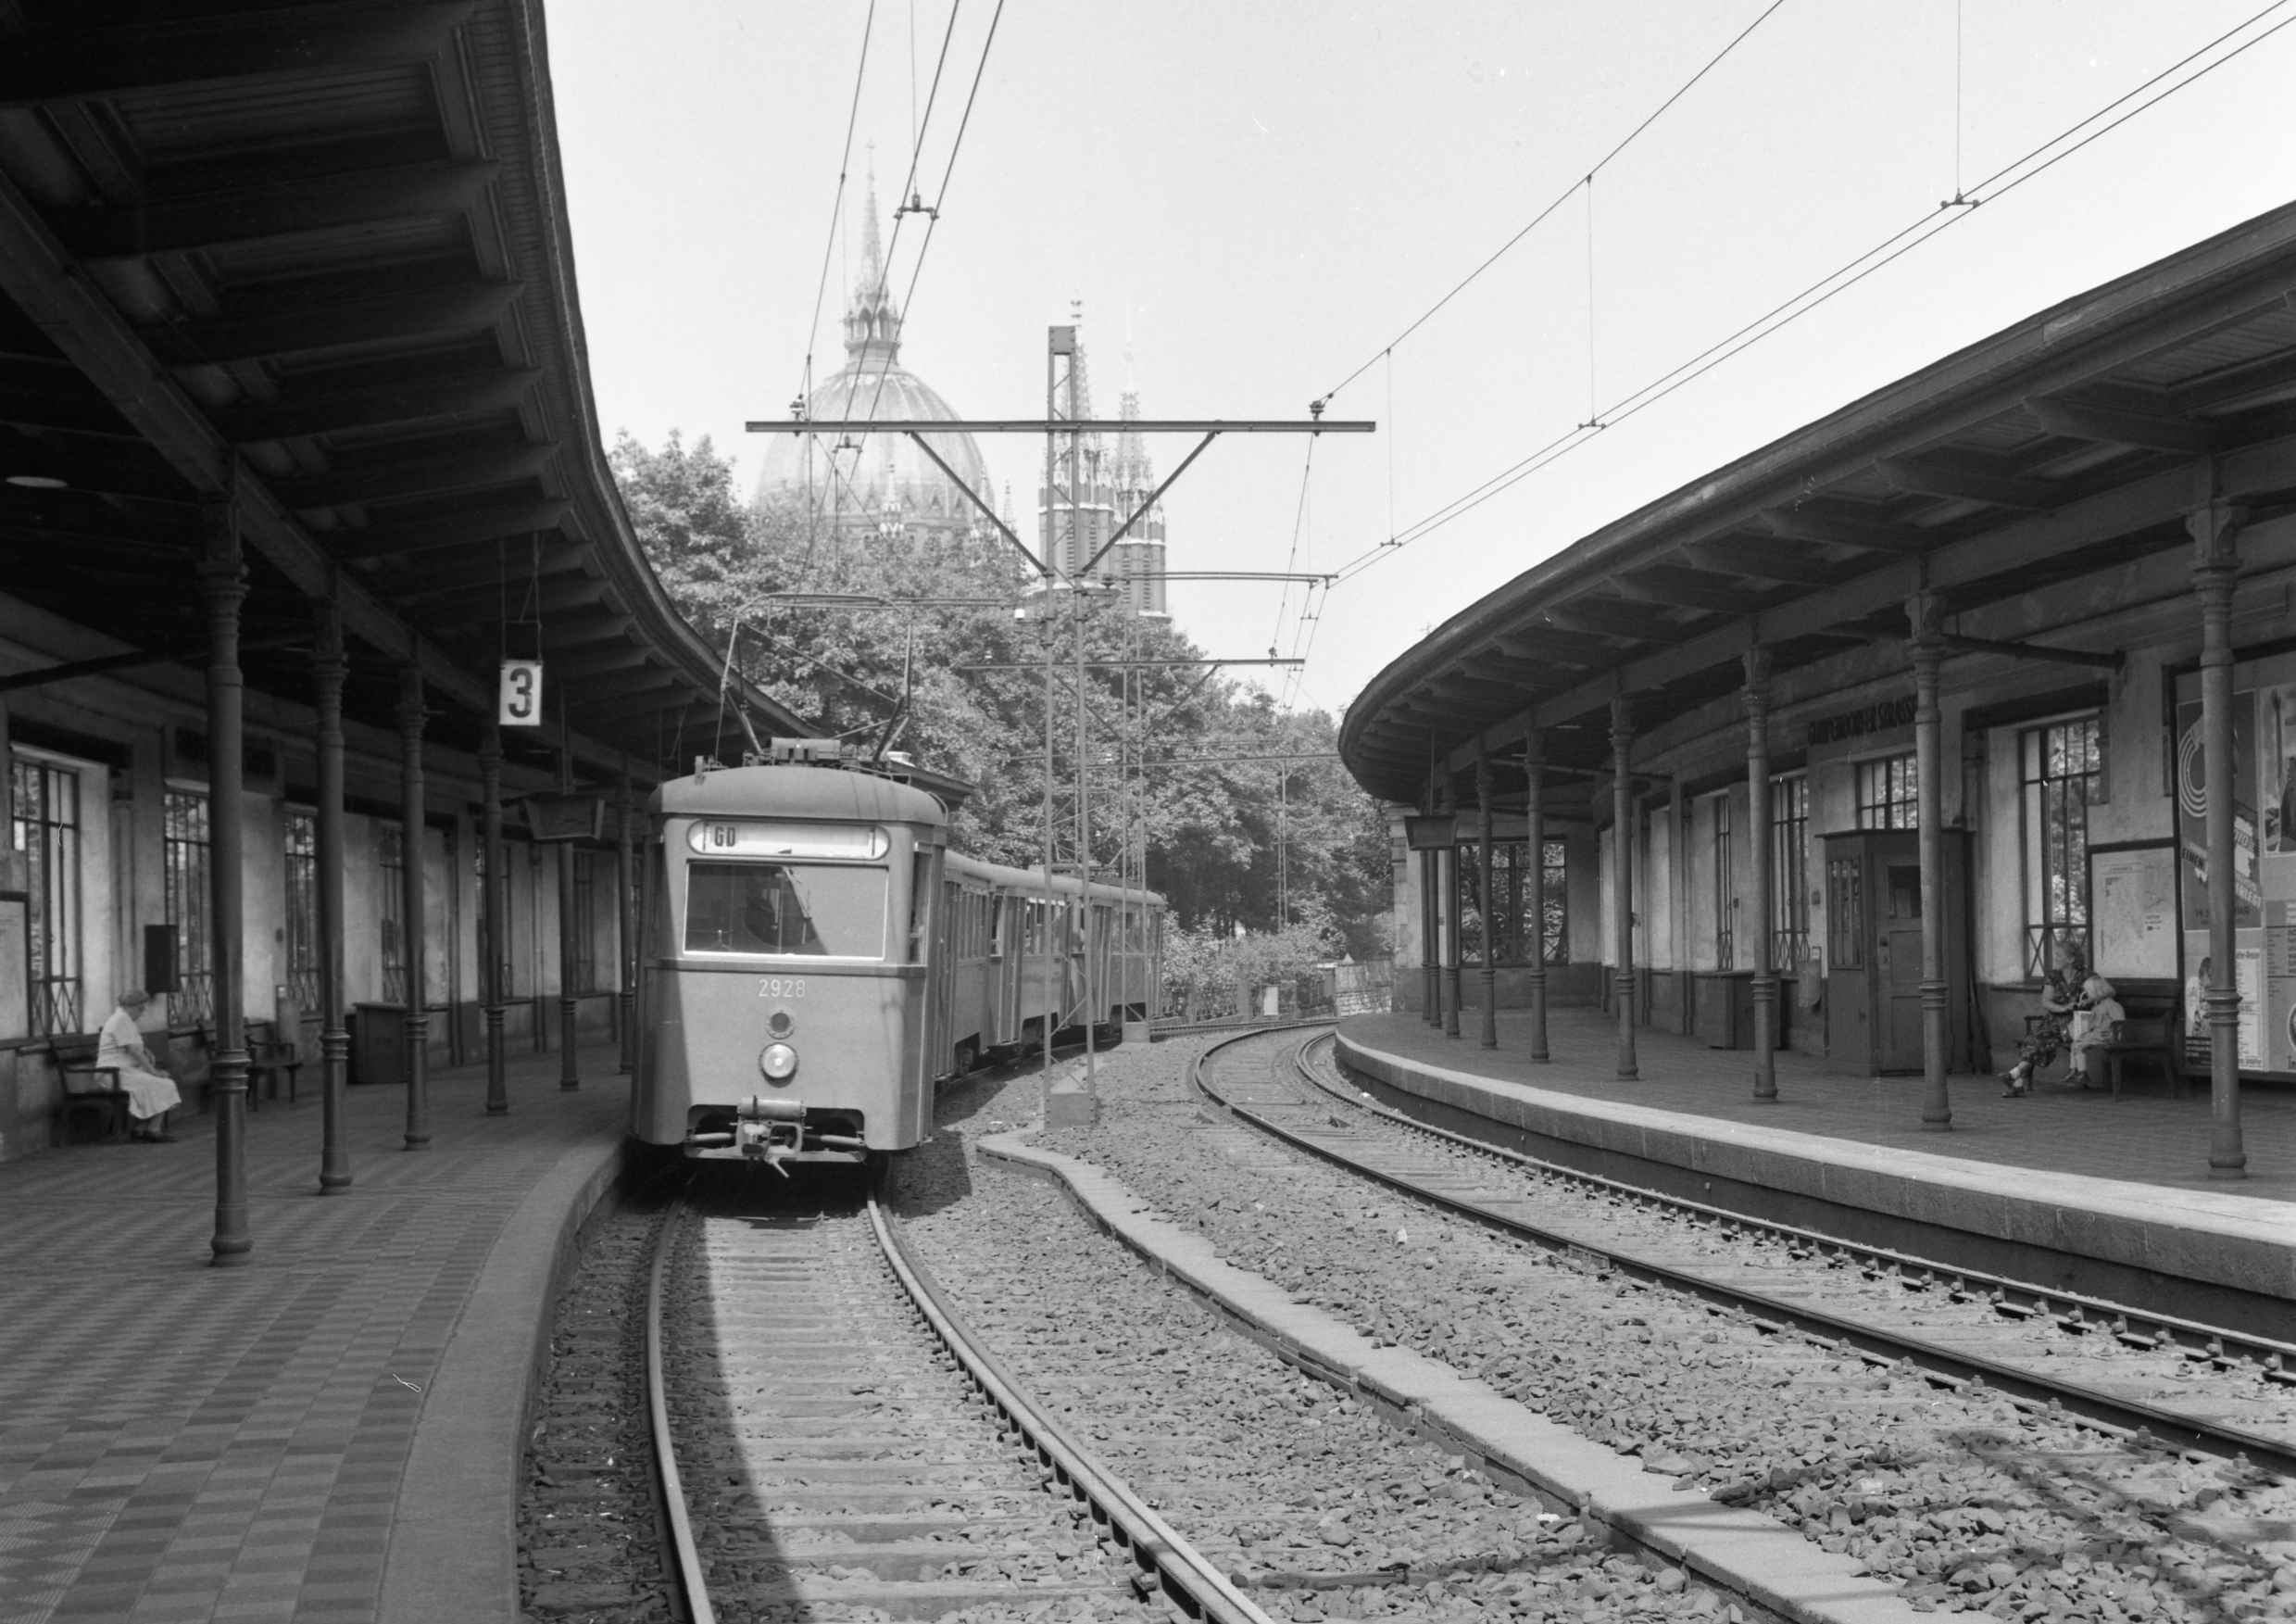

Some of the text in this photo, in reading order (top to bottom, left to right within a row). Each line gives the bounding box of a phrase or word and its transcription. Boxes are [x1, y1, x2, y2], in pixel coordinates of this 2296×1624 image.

[508, 667, 533, 718] 3
[714, 825, 736, 848] GD
[2181, 847, 2204, 869] EINEN
[758, 978, 806, 999] 2928
